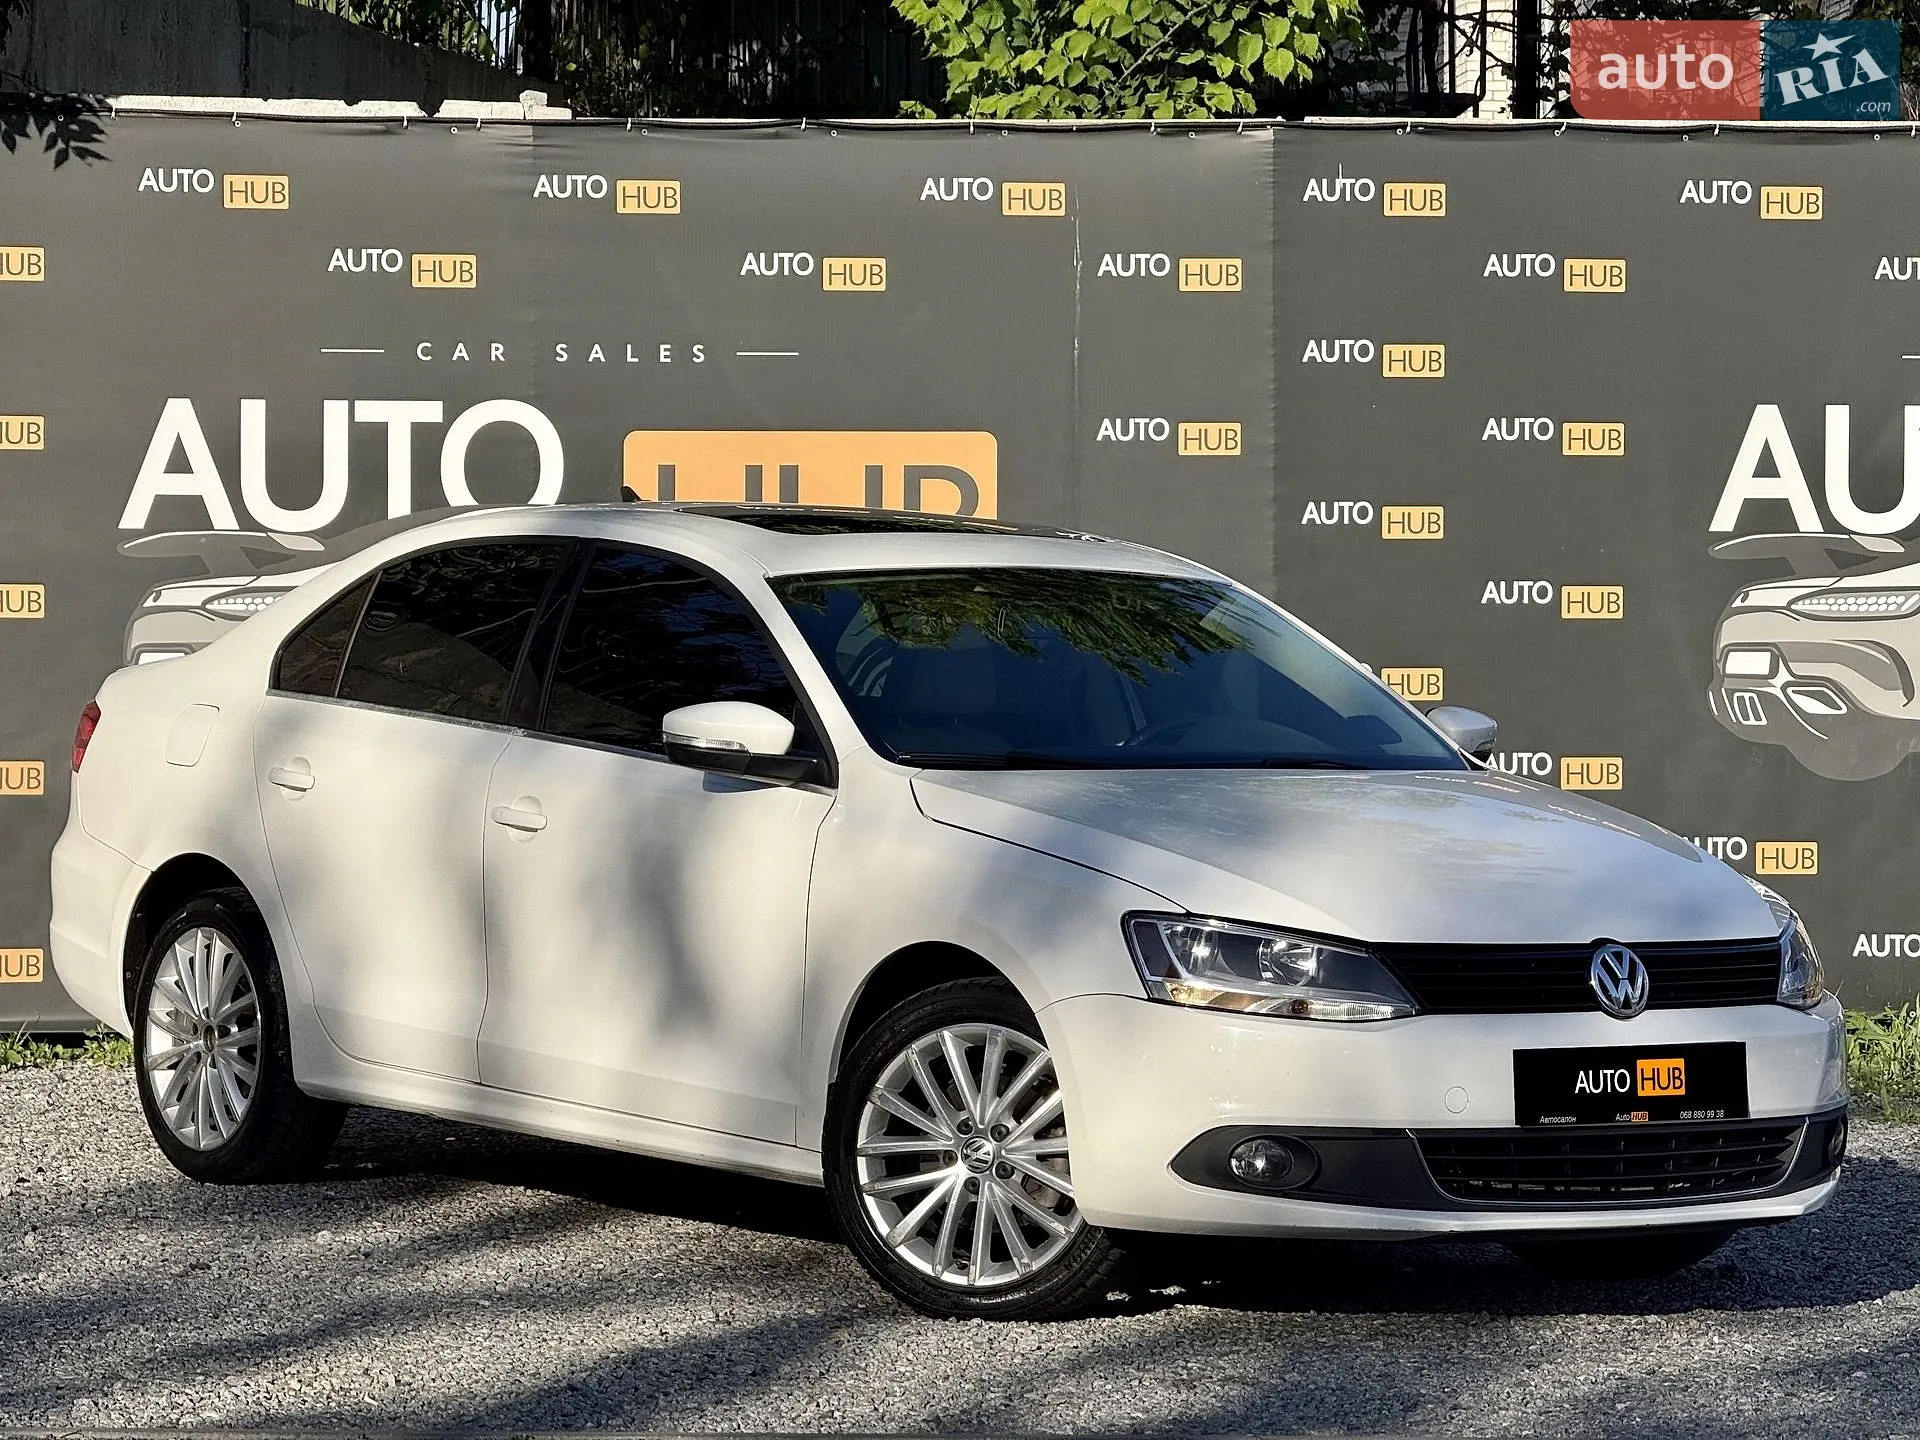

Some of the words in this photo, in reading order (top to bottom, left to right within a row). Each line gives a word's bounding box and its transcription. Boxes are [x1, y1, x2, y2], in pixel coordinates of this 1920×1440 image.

[138, 167, 214, 193] AUTO
[228, 180, 284, 204] HUB
[533, 175, 608, 199] AUTO
[622, 185, 677, 209] HUB
[920, 177, 994, 202] AUTO
[1007, 188, 1064, 212] HUB
[1303, 178, 1376, 202] AUTO
[1388, 188, 1445, 212] HUB
[1680, 180, 1753, 205] AUTO
[1765, 191, 1820, 215] HUB
[0, 252, 42, 276] UB
[328, 248, 403, 273] AUTO
[416, 259, 473, 283] HUB
[740, 252, 815, 276] AUTO
[827, 263, 883, 286] HUB
[1097, 253, 1171, 277] AUTO
[1183, 263, 1241, 287] HUB
[1484, 254, 1556, 278] AUTO
[1568, 264, 1623, 288] HUB
[416, 342, 506, 363] CAR
[555, 343, 707, 364] SALES
[1302, 340, 1375, 363] AUTO
[1387, 350, 1441, 373] HUB
[0, 421, 42, 445] UB
[1096, 418, 1170, 442] AUTO
[1182, 428, 1239, 451] HUB
[1482, 418, 1555, 441] AUTO
[1567, 428, 1621, 451] HUB
[117, 397, 564, 533] AUTO
[1301, 501, 1374, 525] AUTO
[1386, 511, 1440, 535] HUB
[0, 590, 42, 613] UB
[1481, 581, 1554, 605] AUTO
[1566, 591, 1620, 614] HUB
[1386, 673, 1442, 696] HUB
[0, 767, 42, 790] UB
[1565, 762, 1620, 785] HUB
[1760, 847, 1815, 870] HUB
[1852, 933, 1920, 958] AUTO
[0, 954, 41, 978] UB
[1574, 1068, 1631, 1094] AUTO
[1640, 1066, 1684, 1092] HUB
[1615, 1112, 1631, 1122] Auto
[1632, 1112, 1648, 1121] HUB
